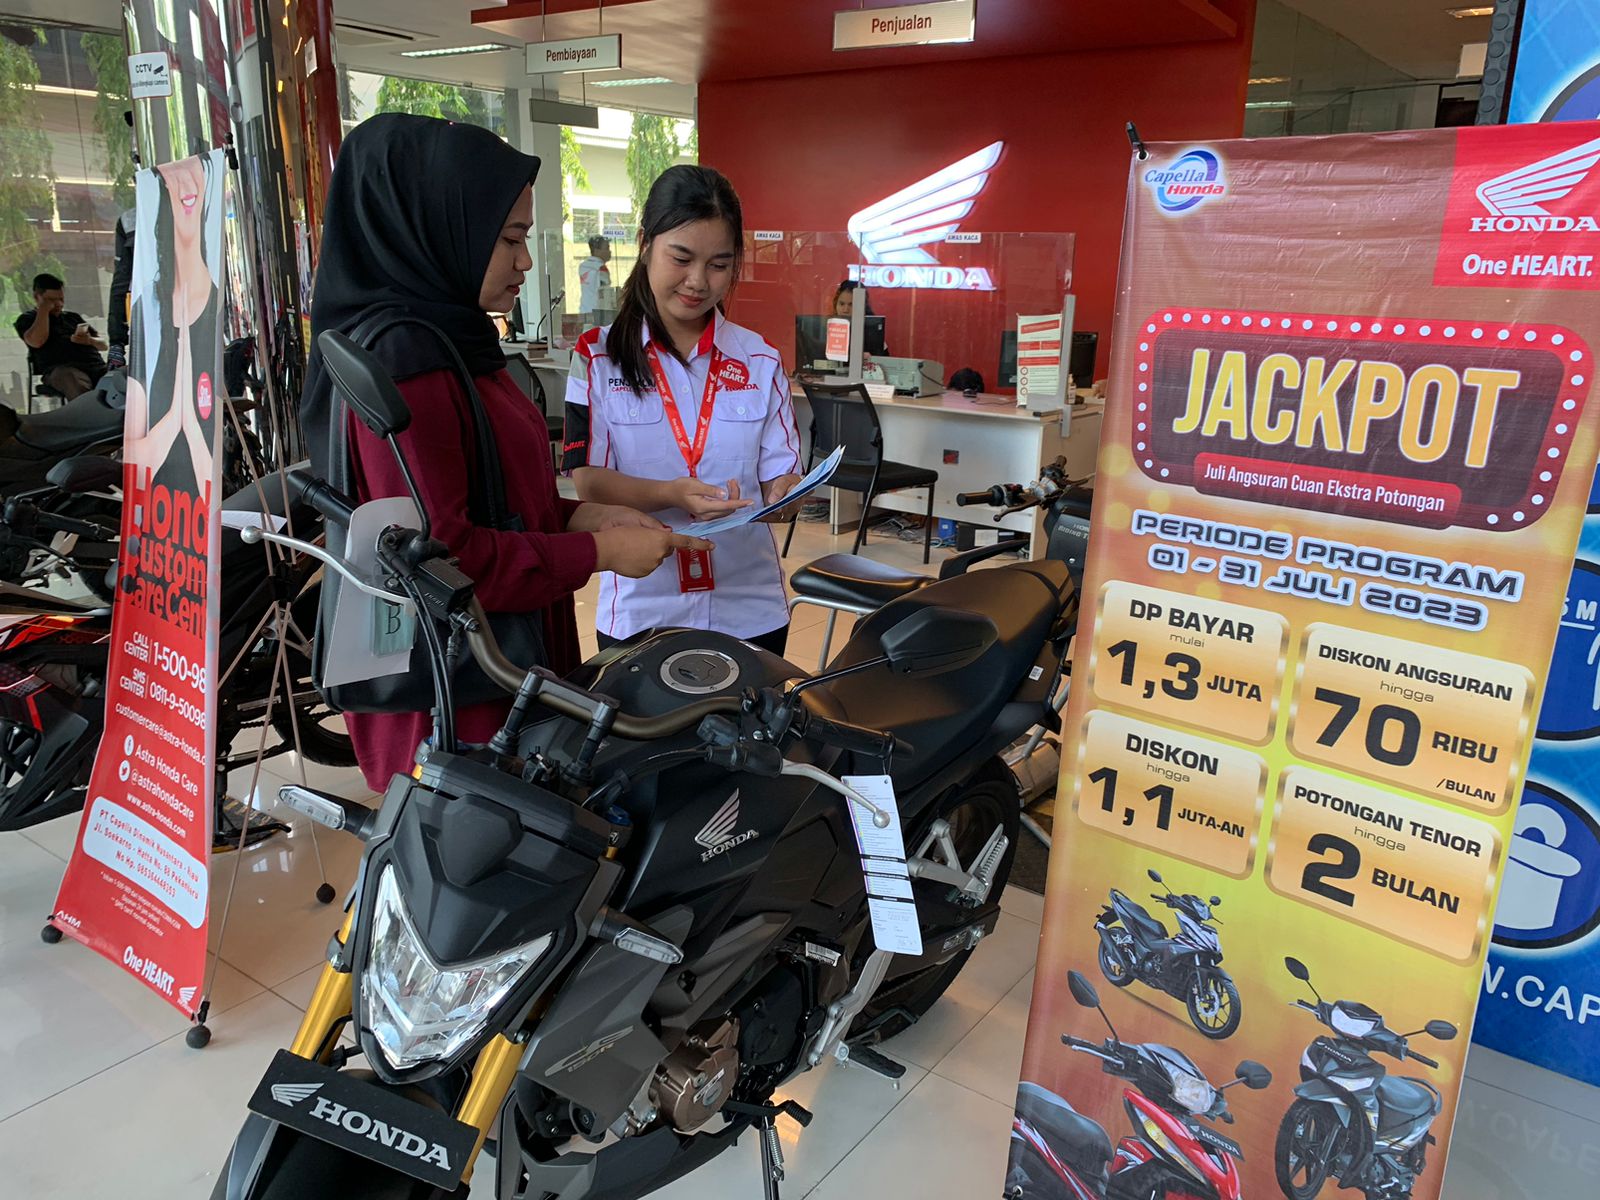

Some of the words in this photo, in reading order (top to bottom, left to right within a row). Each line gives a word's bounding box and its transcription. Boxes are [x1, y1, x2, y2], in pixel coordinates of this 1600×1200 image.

[870, 13, 932, 34] Penjualan
[135, 63, 152, 73] CCTV
[545, 45, 597, 64] Pembiayaan
[1143, 168, 1205, 185] Capella
[1166, 183, 1224, 196] Honda
[1468, 215, 1600, 232] HONDA
[847, 264, 997, 291] HONDA
[1462, 253, 1507, 277] One
[1510, 254, 1593, 276] HEART.
[726, 364, 742, 375] One
[1171, 347, 1521, 469] JACKPOT
[1203, 462, 1226, 480] Juli
[1227, 465, 1288, 491] Angsuran
[1290, 475, 1324, 495] Cuan
[1326, 479, 1372, 502] Ekstra
[1374, 486, 1445, 513] Potongan
[1133, 511, 1290, 558] PERIODE
[1300, 540, 1520, 598] PROGRAM
[1151, 546, 1184, 570] 01
[1222, 558, 1257, 584] 31
[1267, 568, 1351, 602] JULI
[1363, 584, 1484, 628] 2023
[385, 604, 401, 635] B
[1129, 599, 1162, 622] DP
[1167, 604, 1255, 644] BAYAR
[123, 640, 149, 663] CENTER
[133, 631, 149, 649] CALL
[1169, 632, 1205, 648] mulai
[132, 667, 146, 685] SMS
[1106, 639, 1201, 702] 1,3
[1206, 674, 1263, 703] JUTA
[1318, 643, 1392, 674] DISKON
[1394, 662, 1513, 702] ANGSURAN
[120, 675, 145, 698] CENTER
[1379, 680, 1435, 704] hingga
[1312, 687, 1422, 767] 70
[1430, 730, 1498, 764] RIBU
[1125, 732, 1219, 777] DISKON
[135, 743, 155, 767] Astra
[156, 756, 180, 784] Honda
[181, 773, 198, 796] Care
[1145, 760, 1191, 784] hingga
[131, 768, 195, 822] @astrahondacare
[1087, 766, 1175, 832] 1,1
[1177, 808, 1245, 839] JUTA-AN
[1435, 777, 1496, 803] /BULAN
[126, 792, 187, 839] www.astra-honda.com
[1293, 784, 1404, 832] POTONGAN
[1408, 820, 1483, 859] TENOR
[701, 828, 760, 863] HONDA
[1353, 825, 1407, 852] hingga
[1300, 833, 1362, 907] 2
[1370, 867, 1460, 915] BULAN
[123, 945, 142, 972] One
[141, 956, 175, 996] HEART.
[308, 1095, 453, 1172] HONDA
[1200, 1130, 1241, 1156] HONDA
